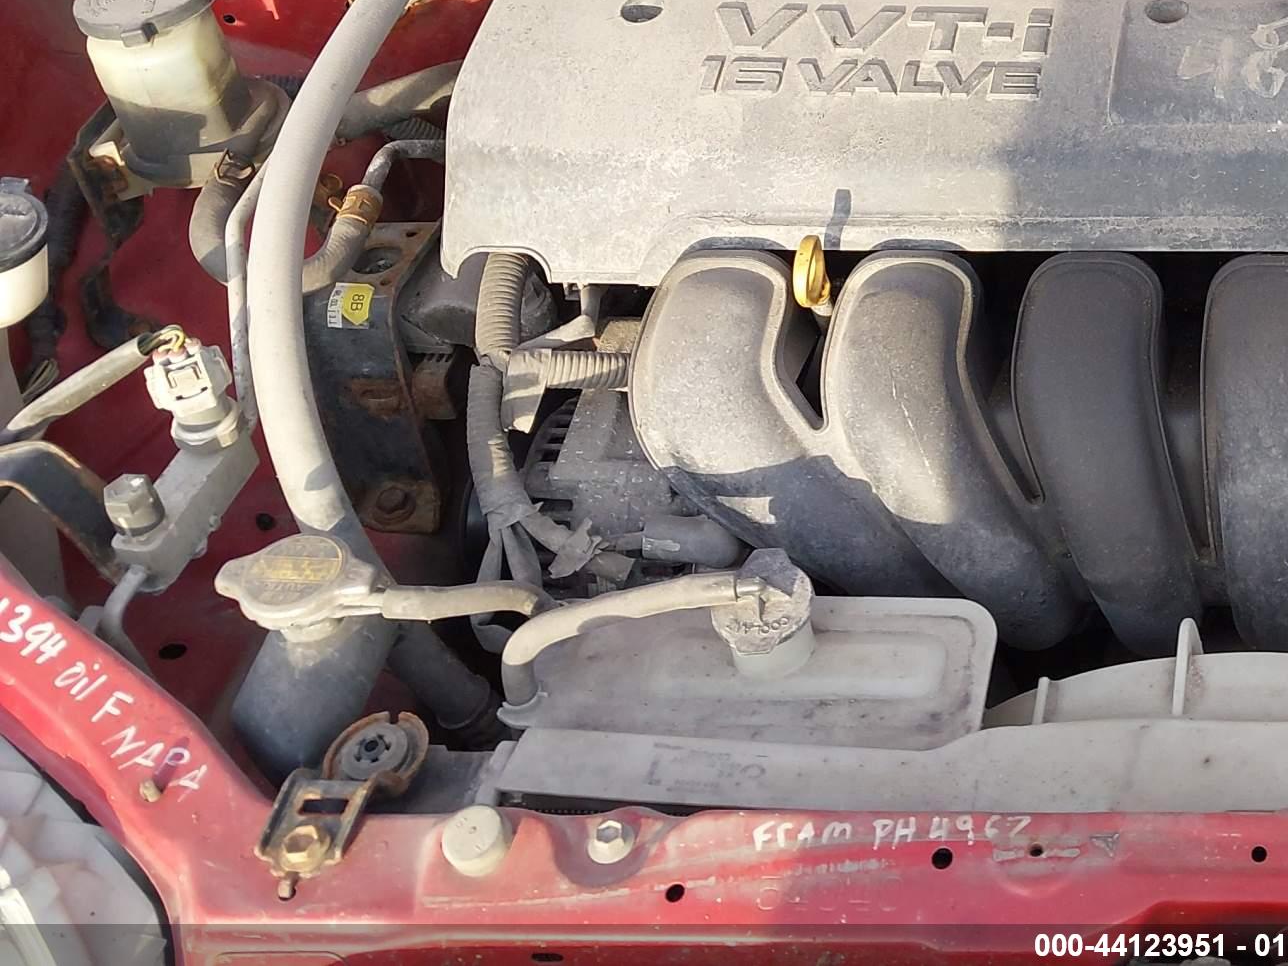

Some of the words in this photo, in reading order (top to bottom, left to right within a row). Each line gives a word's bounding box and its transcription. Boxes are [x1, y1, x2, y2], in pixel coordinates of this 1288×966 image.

[714, 0, 1056, 56] VVT-i
[699, 54, 788, 94] 16
[797, 56, 1042, 100] VALVE
[91, 690, 134, 722] F
[101, 725, 208, 803] NAPA
